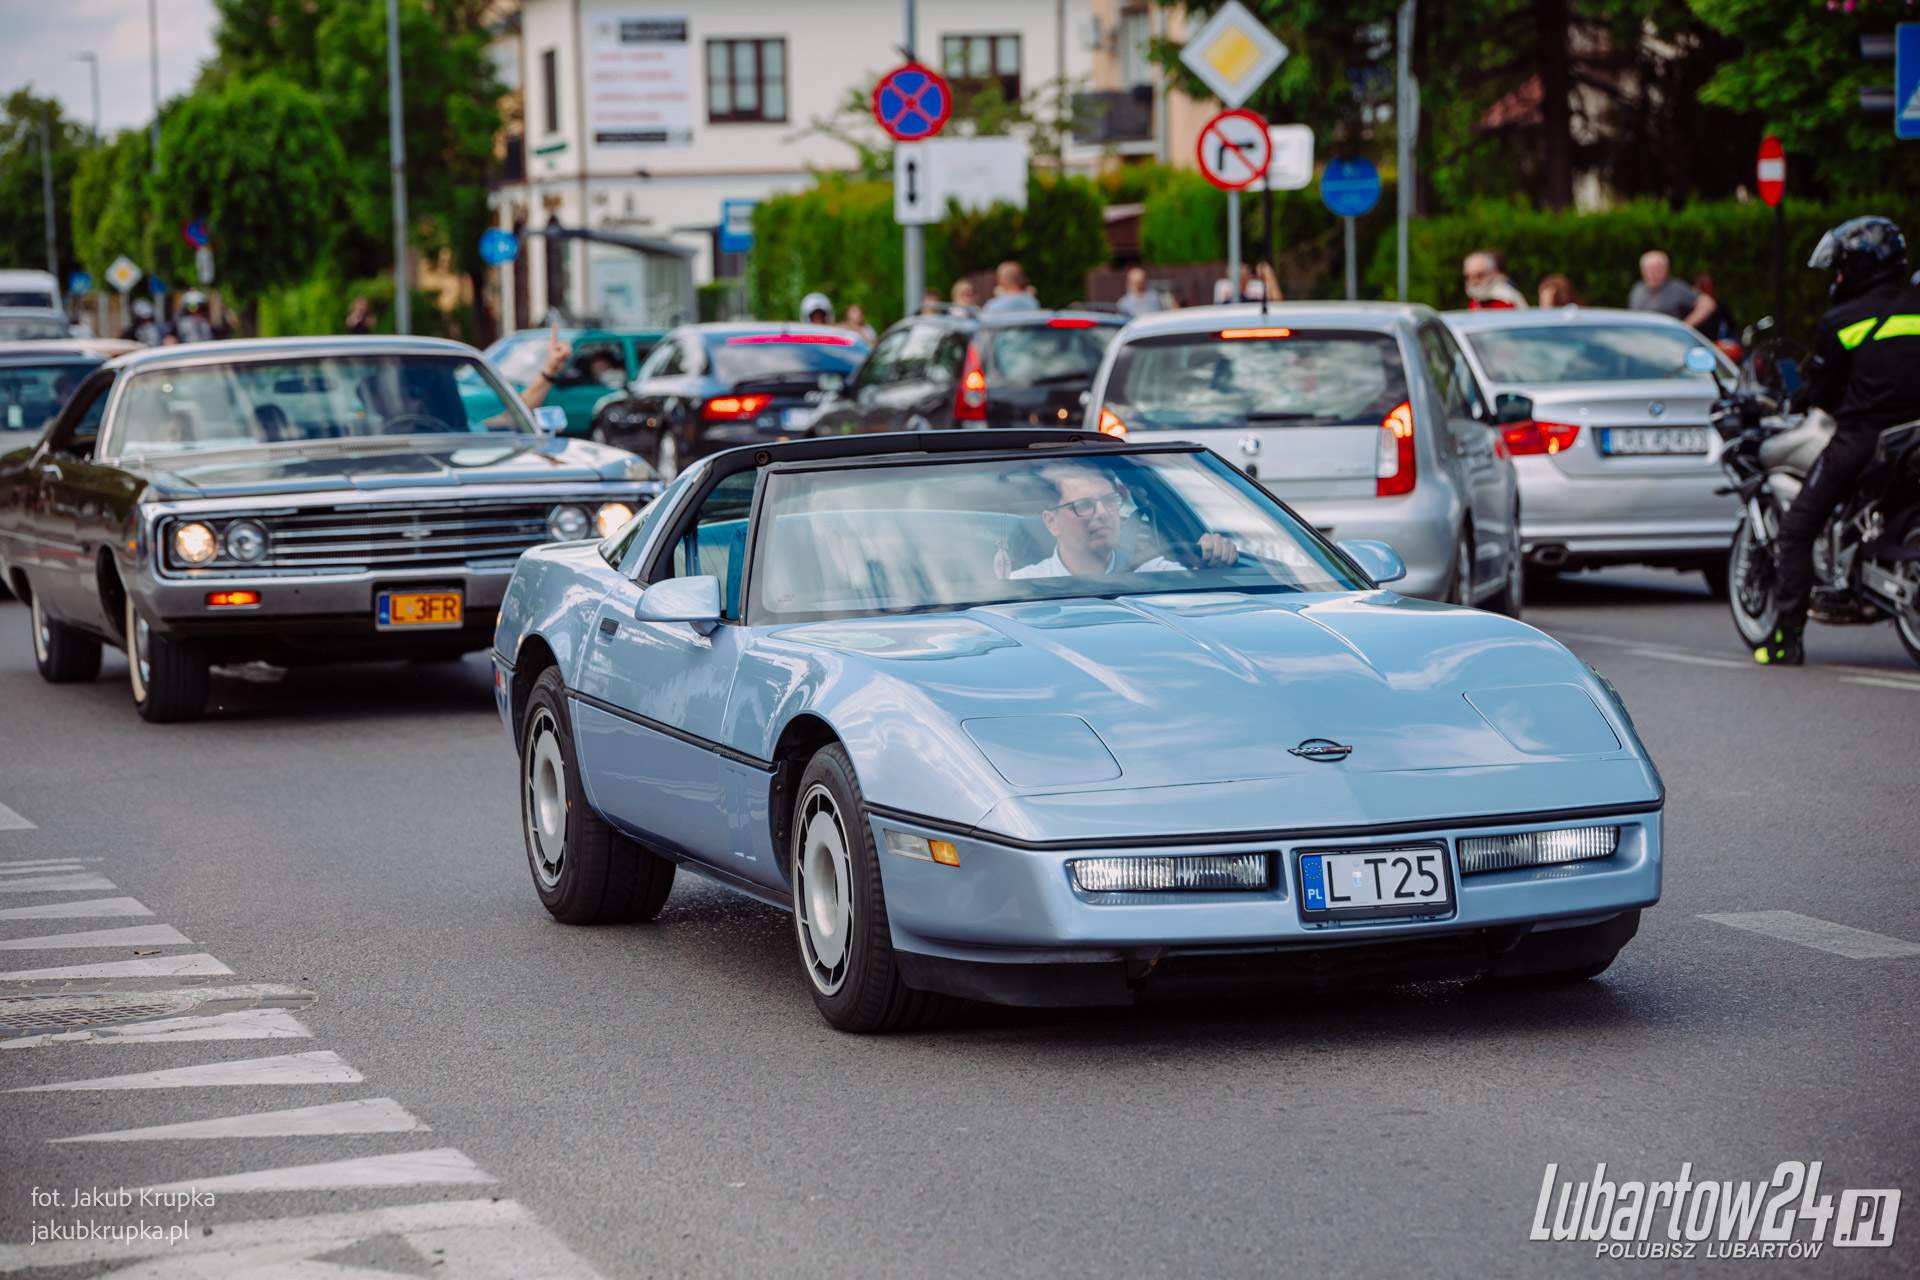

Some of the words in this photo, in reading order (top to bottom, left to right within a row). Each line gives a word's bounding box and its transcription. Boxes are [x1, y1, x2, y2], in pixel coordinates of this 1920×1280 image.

[391, 596, 405, 621] L
[416, 596, 457, 620] 3FR
[1326, 860, 1351, 902] L
[1364, 855, 1439, 900] T25
[1307, 888, 1323, 900] PL
